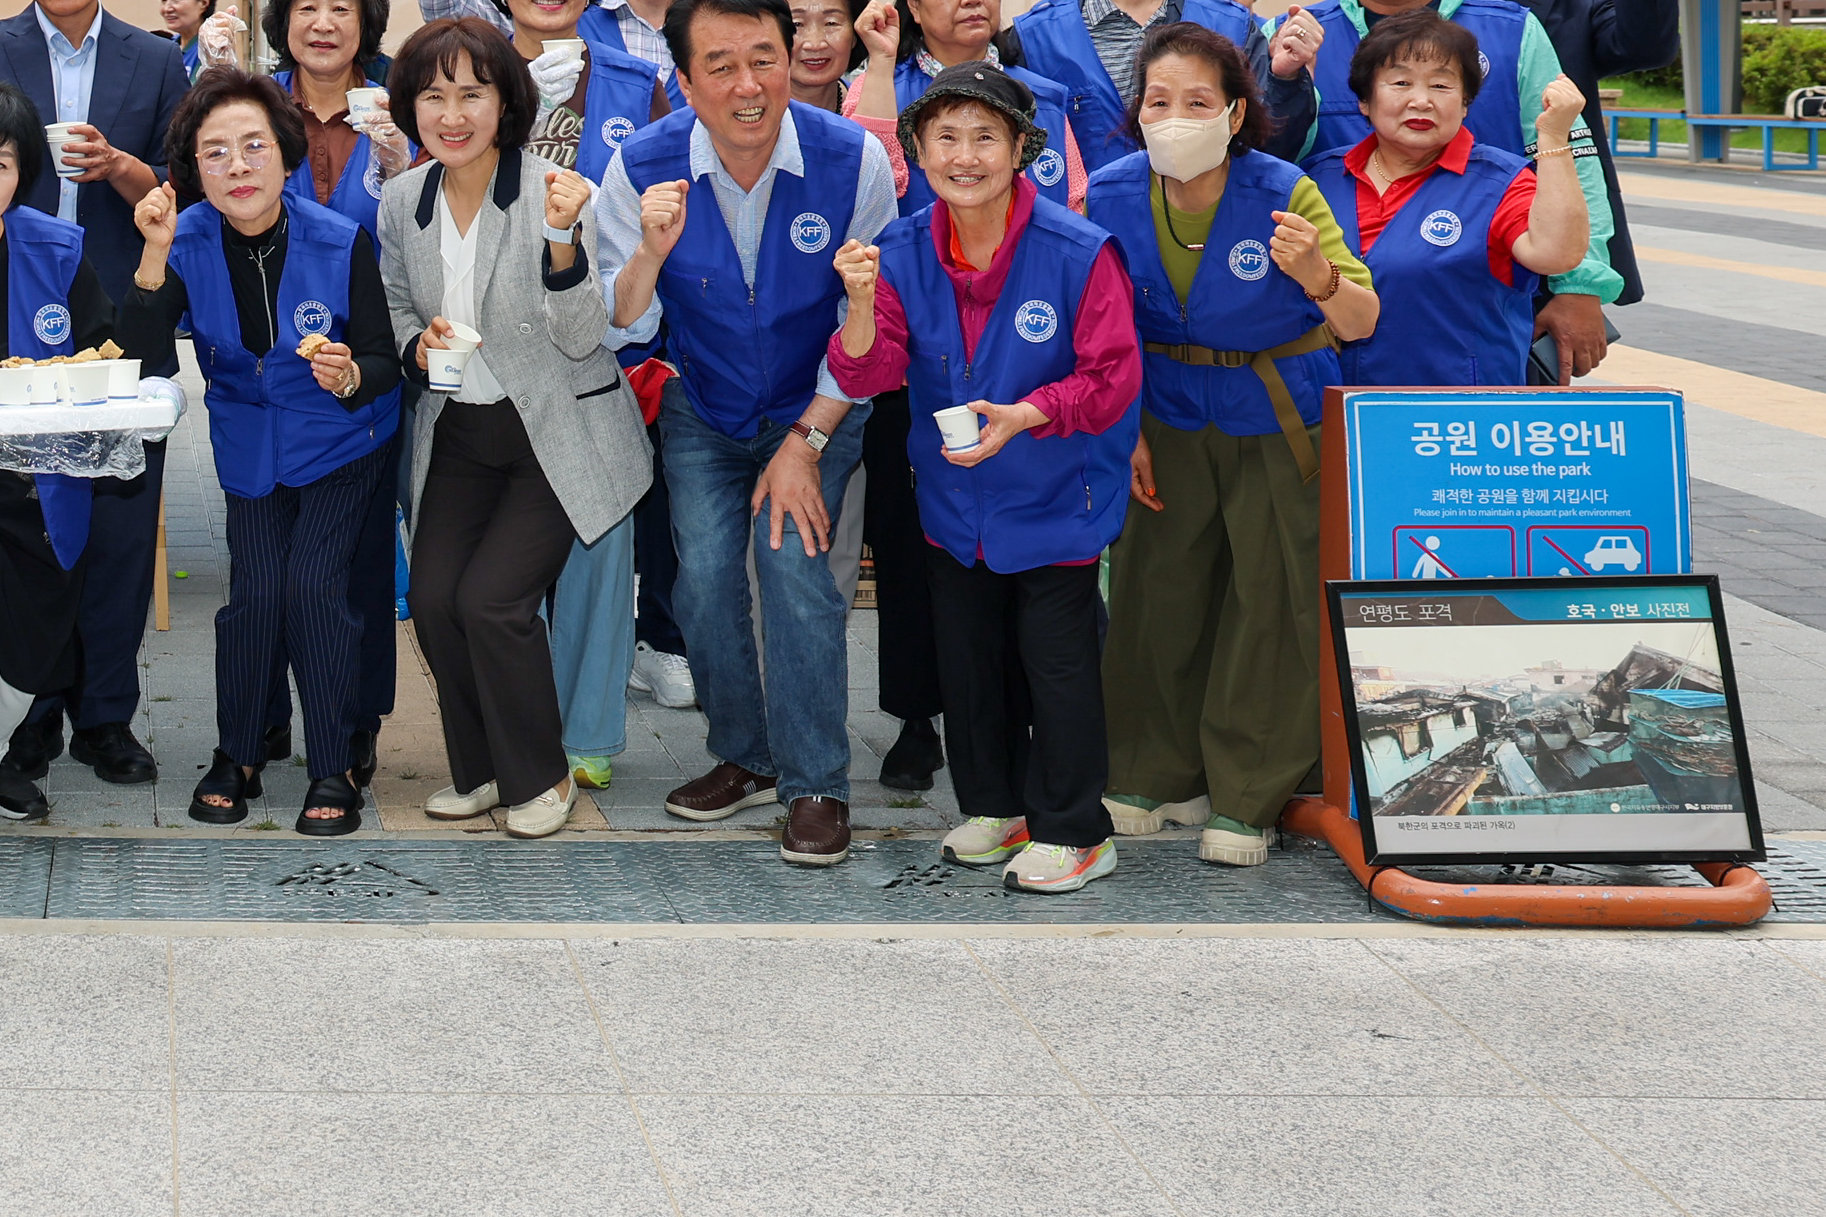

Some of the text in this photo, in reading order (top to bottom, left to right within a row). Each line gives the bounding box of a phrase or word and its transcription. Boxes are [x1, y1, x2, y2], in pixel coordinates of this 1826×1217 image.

[609, 128, 630, 139] KFF
[1038, 158, 1056, 173] KFF
[799, 226, 823, 237] KFF
[1429, 221, 1454, 233] KFF
[1238, 253, 1263, 265] KFF
[41, 317, 65, 330] KFF
[302, 313, 324, 325] KFF
[1024, 313, 1051, 327] KFF
[1410, 420, 1627, 457] 공원 이용안내
[1450, 461, 1592, 479] How to use the park
[1431, 488, 1609, 504] 쾌적한 공원을 함께 지킵시다
[1413, 508, 1441, 517] Please
[1441, 508, 1458, 520] join
[1458, 508, 1467, 517] in
[1468, 509, 1478, 517] to
[1478, 508, 1515, 517] maintain
[1523, 508, 1558, 520] pleasant
[1558, 508, 1578, 520] park
[1578, 508, 1632, 517] environment
[1359, 603, 1453, 623] 연평도 포격
[1567, 604, 1597, 618] 호국
[1610, 603, 1642, 618] 안보
[1646, 602, 1691, 618] 사진전
[1397, 820, 1516, 831] 북한군의 포격으로 파괴된 가옥(2)
